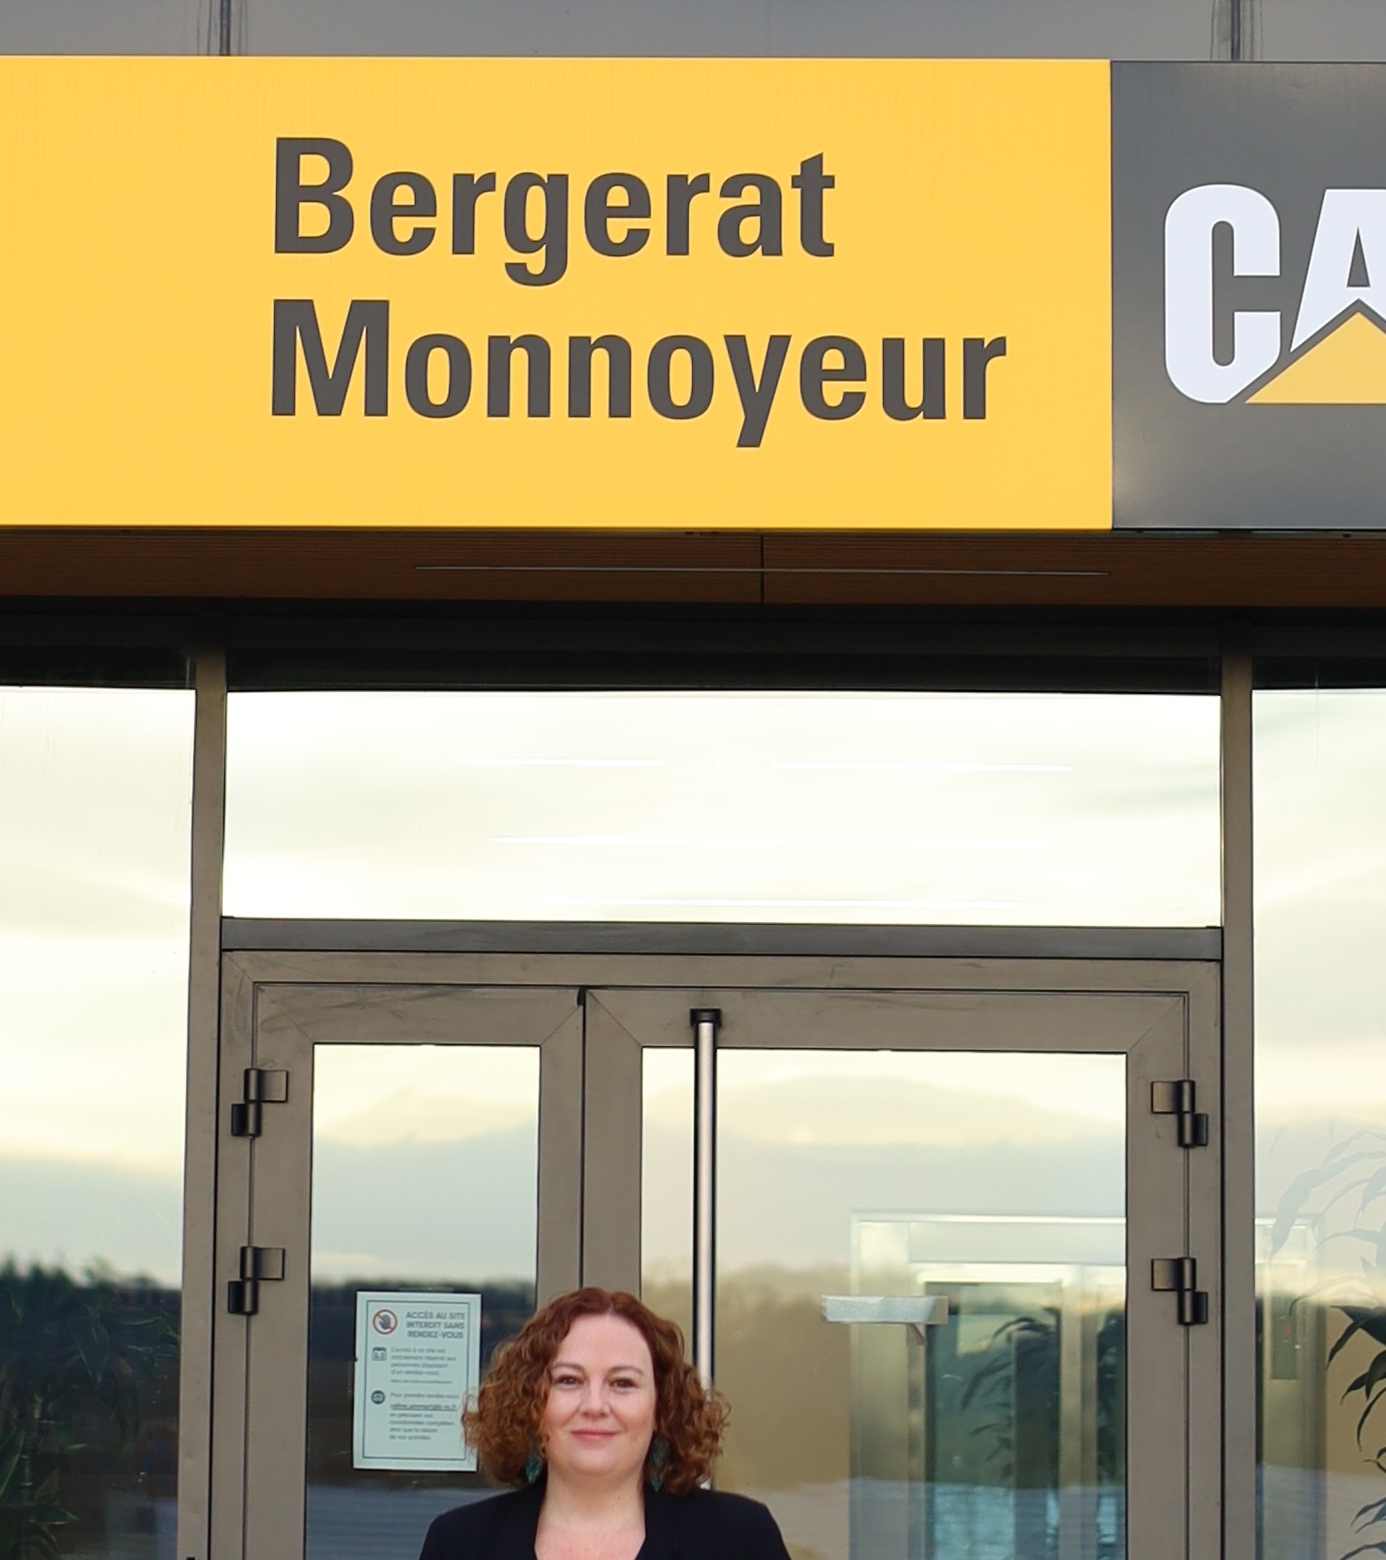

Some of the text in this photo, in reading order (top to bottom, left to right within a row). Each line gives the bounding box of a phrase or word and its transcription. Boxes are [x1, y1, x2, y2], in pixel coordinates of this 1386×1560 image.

[274, 137, 836, 287] Bergerat
[271, 298, 1007, 448] Monnoyeur
[405, 1310, 465, 1320] ACCÈS AU SITE
[406, 1321, 464, 1330] INTERDIT SANS
[407, 1330, 464, 1339] RENDEZ-VOUS
